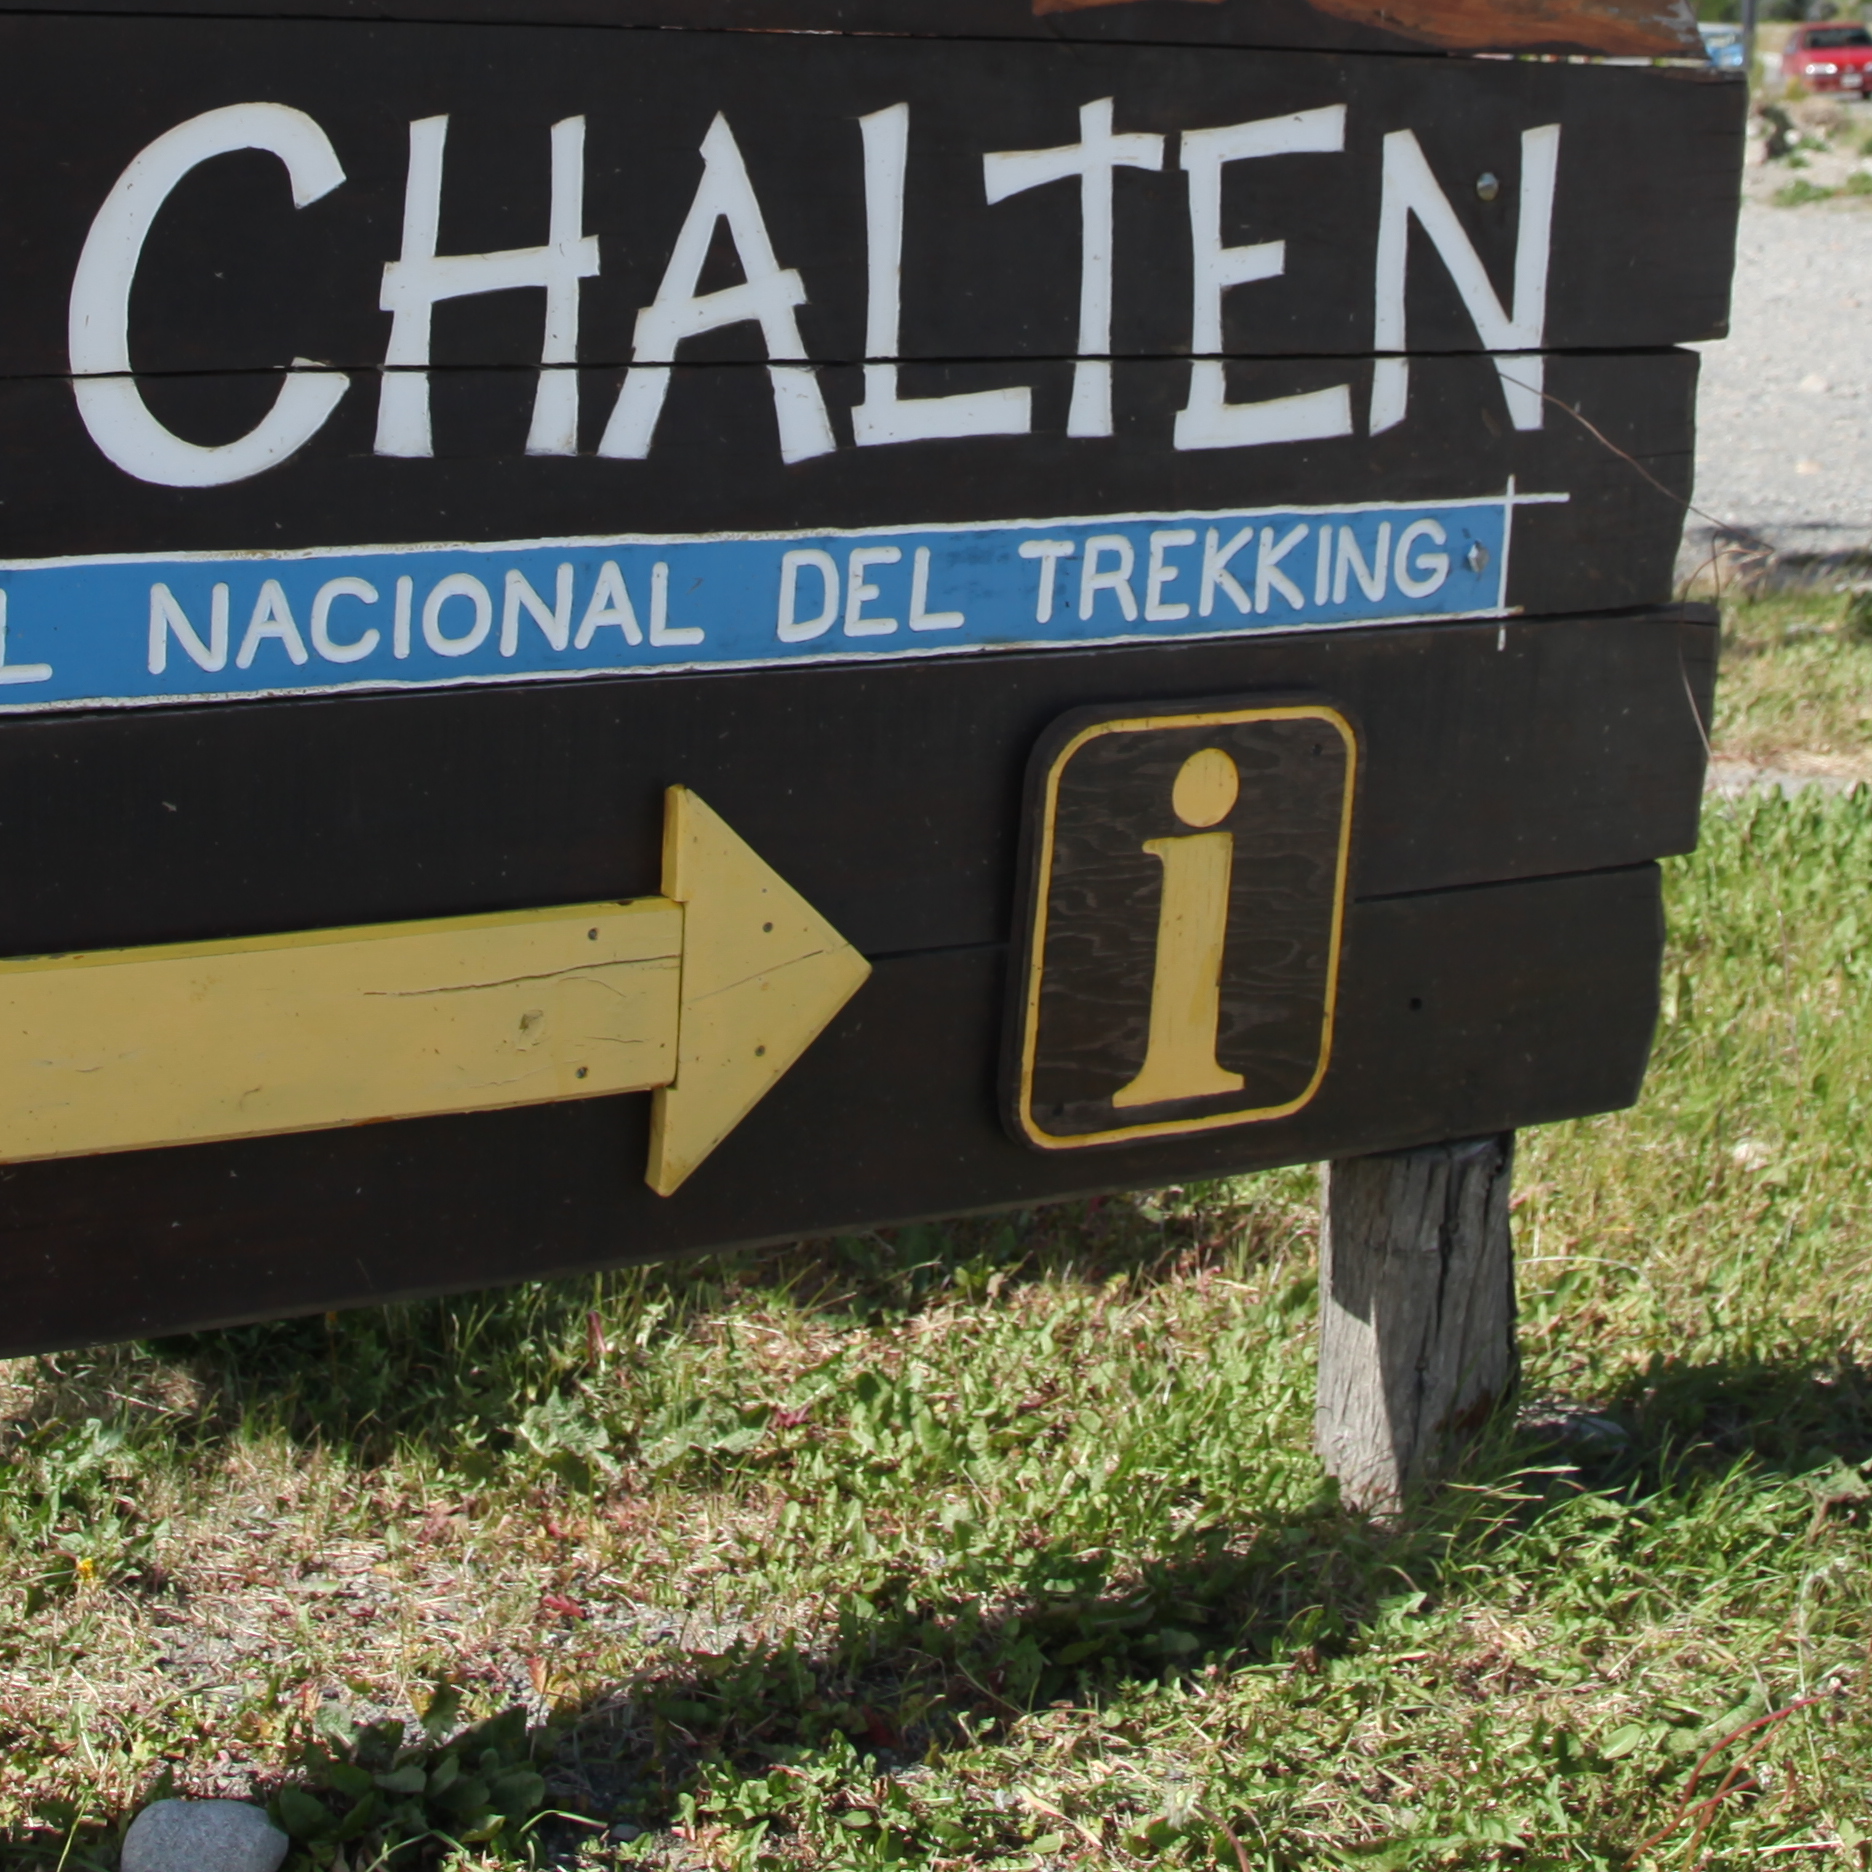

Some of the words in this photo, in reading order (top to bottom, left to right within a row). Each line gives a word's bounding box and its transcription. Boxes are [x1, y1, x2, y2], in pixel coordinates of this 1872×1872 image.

[68, 96, 1562, 487] CHALTEN
[147, 561, 706, 676] NACIONAL
[776, 545, 966, 644] DEL
[1018, 518, 1451, 625] TREKKING
